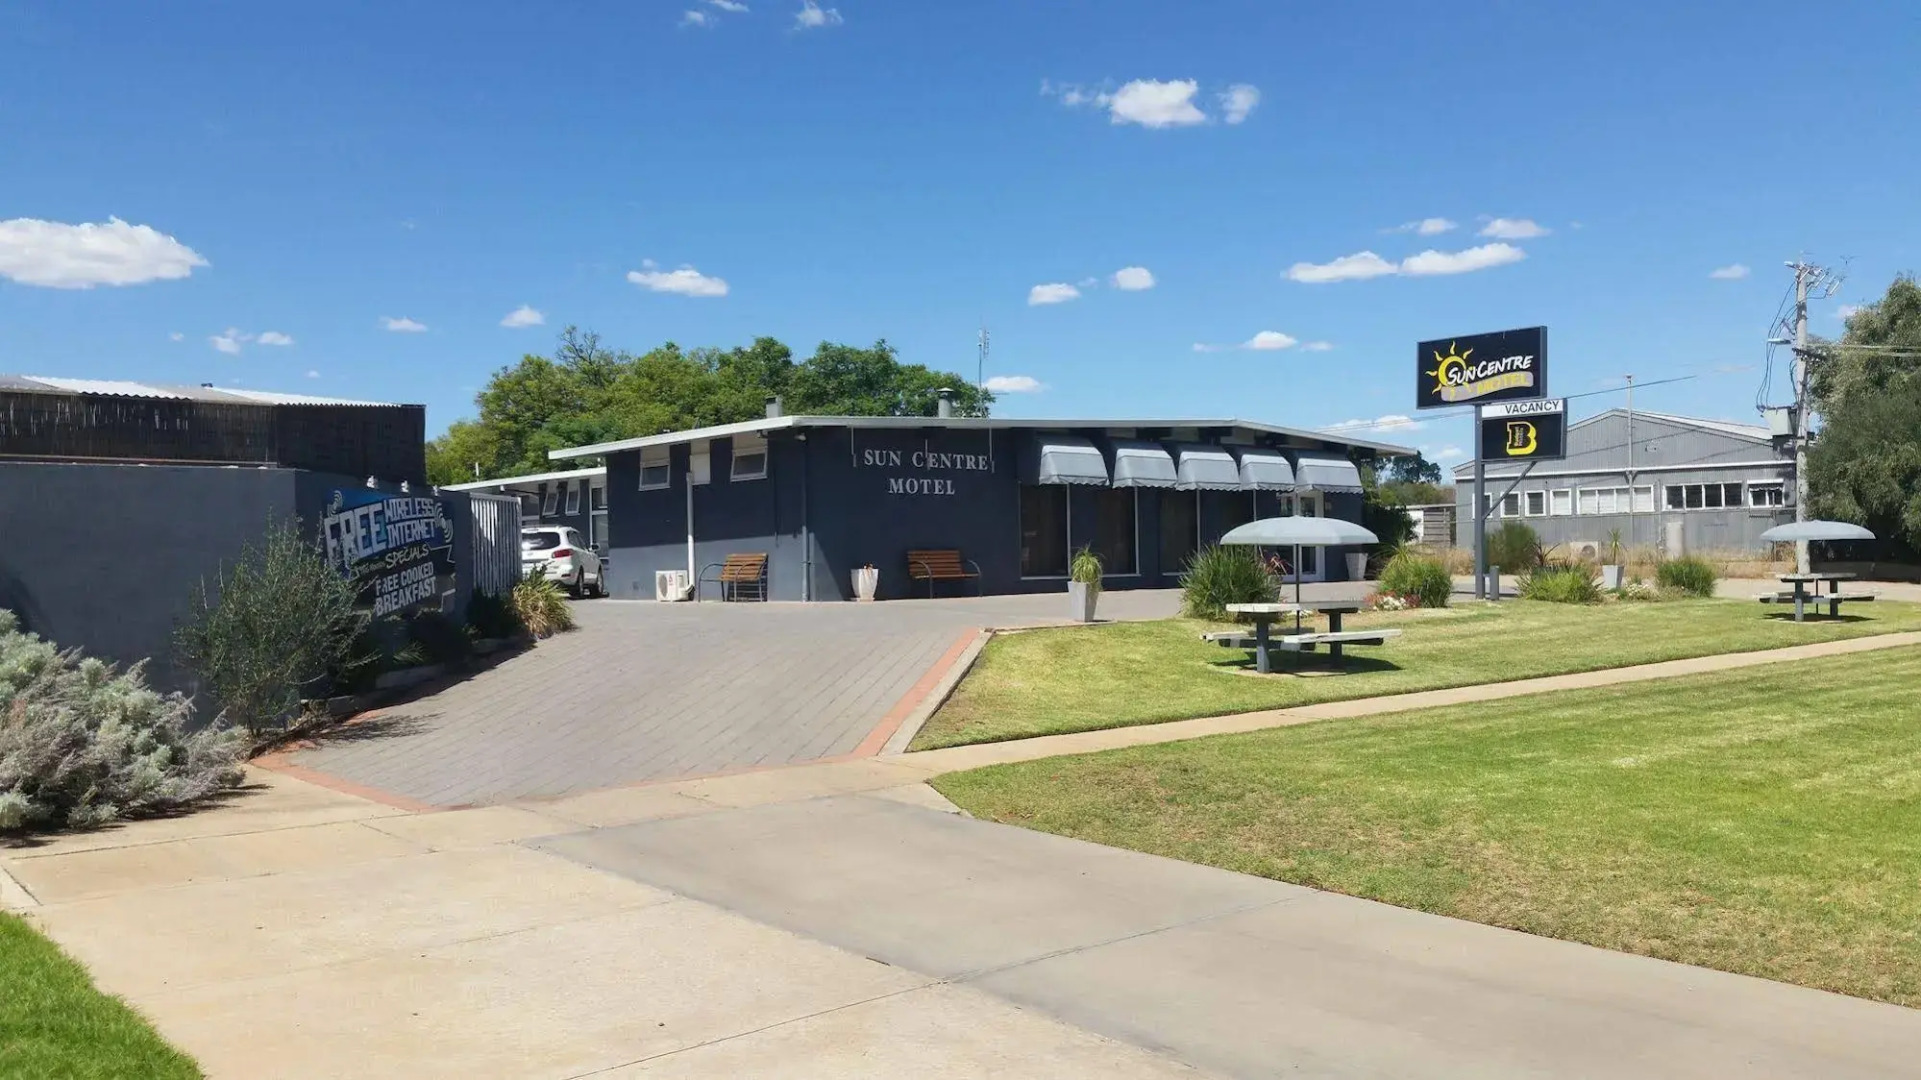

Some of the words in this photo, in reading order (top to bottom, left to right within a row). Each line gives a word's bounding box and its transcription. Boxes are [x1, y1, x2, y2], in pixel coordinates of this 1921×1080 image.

[1505, 401, 1559, 415] VACANCY
[864, 450, 902, 466] SUN
[912, 452, 988, 470] CENTRE
[888, 478, 955, 495] MOTEL
[384, 498, 435, 521] WIRELESS
[325, 503, 385, 568] FREE
[386, 519, 435, 548] INTERNET
[385, 544, 429, 569] SPECIALS
[376, 573, 399, 595] FREE
[401, 562, 433, 585] COOKED
[375, 578, 436, 616] BREAKFAST
